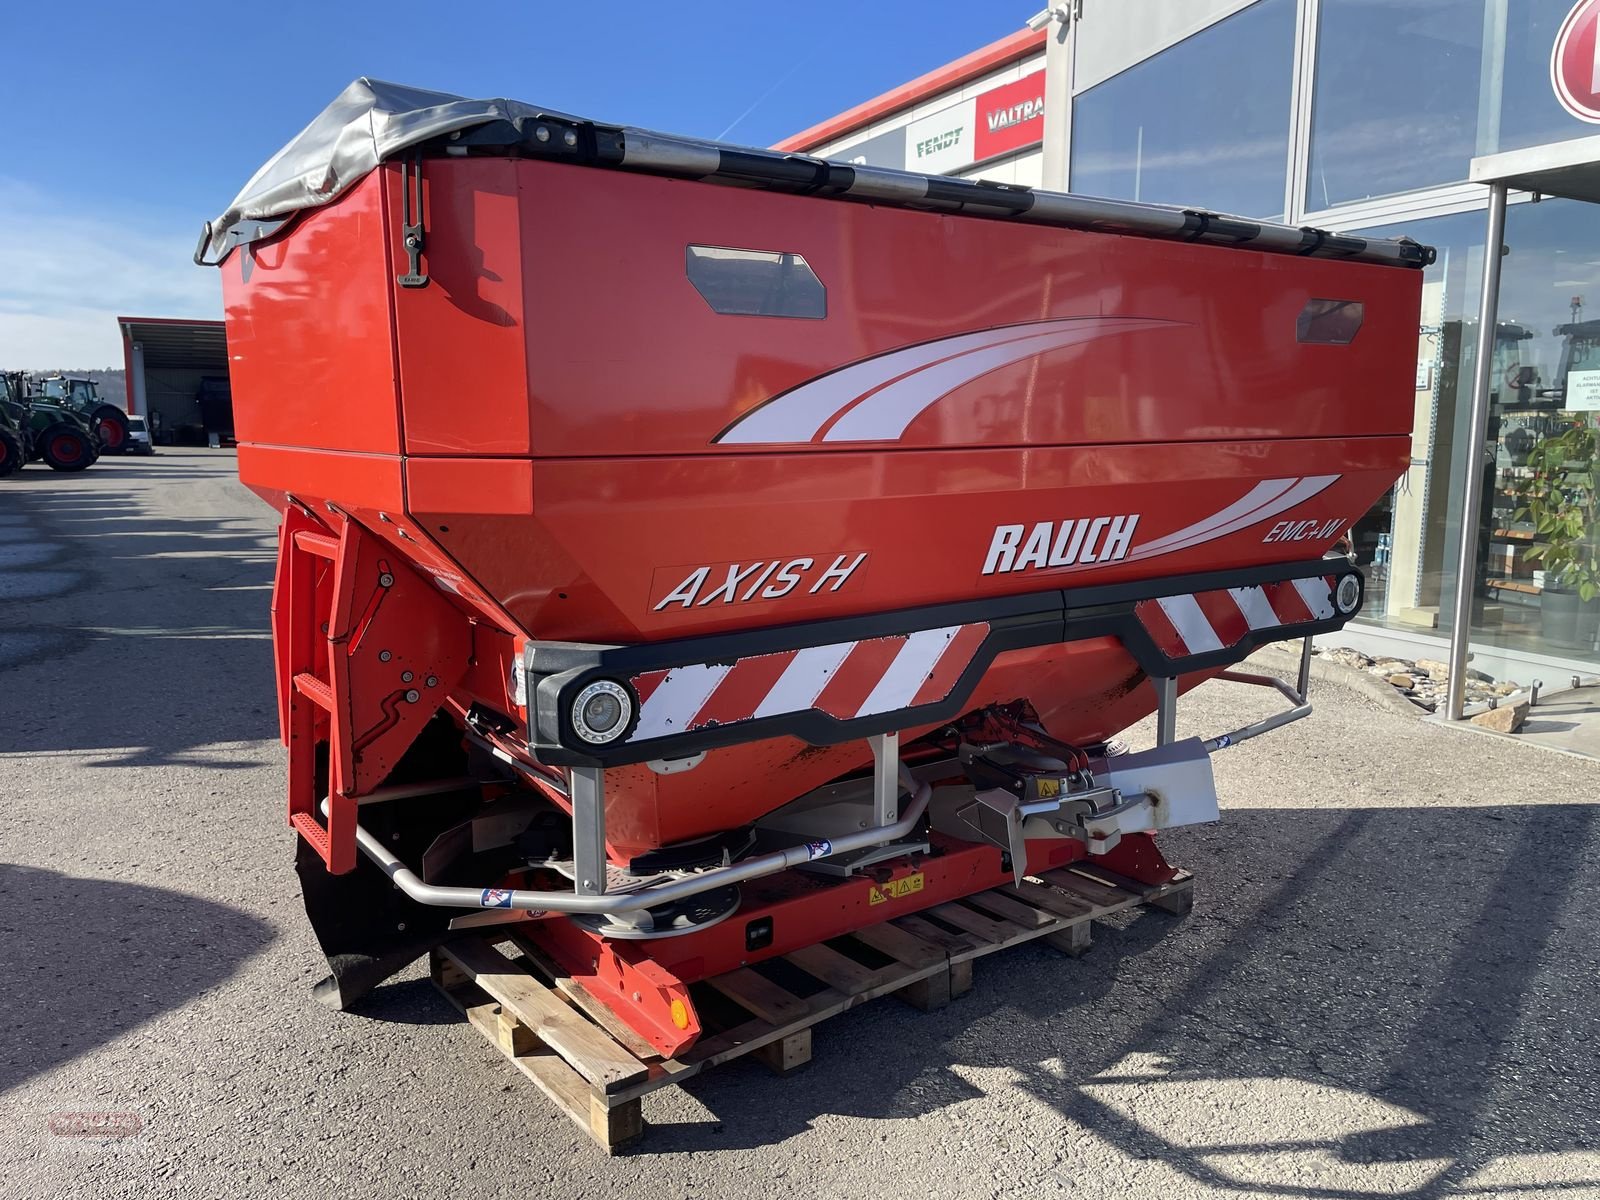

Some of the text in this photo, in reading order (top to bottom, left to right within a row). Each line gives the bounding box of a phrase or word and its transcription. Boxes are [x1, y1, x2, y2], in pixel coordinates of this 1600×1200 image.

[987, 96, 1044, 133] VALTRA
[916, 126, 964, 158] FENDT
[982, 514, 1140, 576] RAUCH
[1262, 518, 1347, 543] EMC+W
[653, 552, 868, 611] AXIS H
